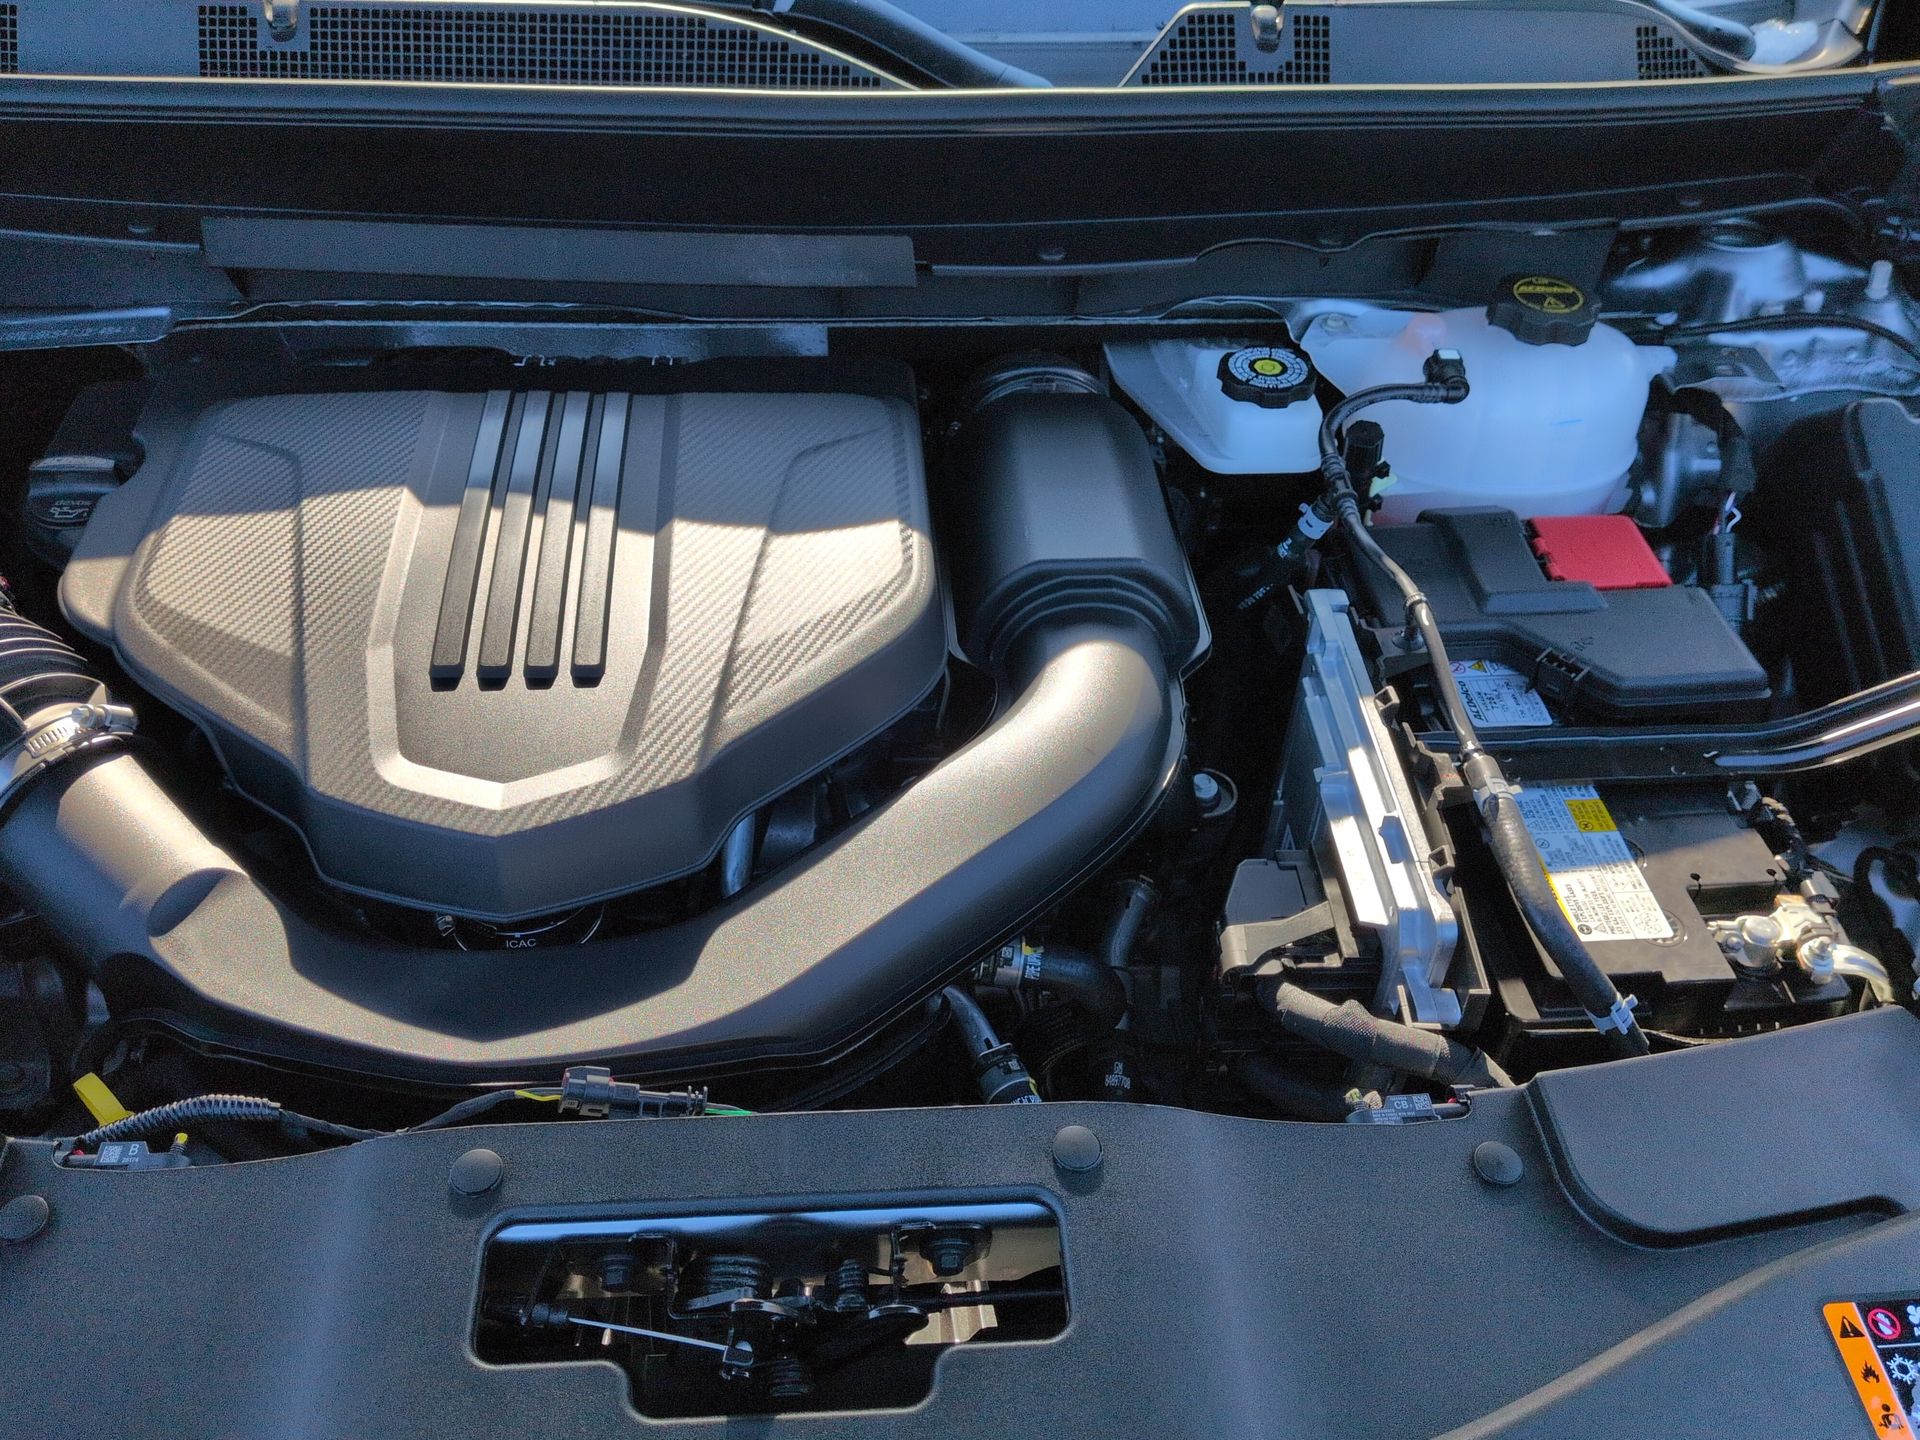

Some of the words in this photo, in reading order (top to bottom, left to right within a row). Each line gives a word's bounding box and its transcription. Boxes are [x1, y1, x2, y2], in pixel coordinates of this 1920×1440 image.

[1458, 680, 1485, 721] ACDelco
[506, 938, 537, 949] ICAC
[1394, 1100, 1409, 1109] CB
[128, 1143, 139, 1156] B
